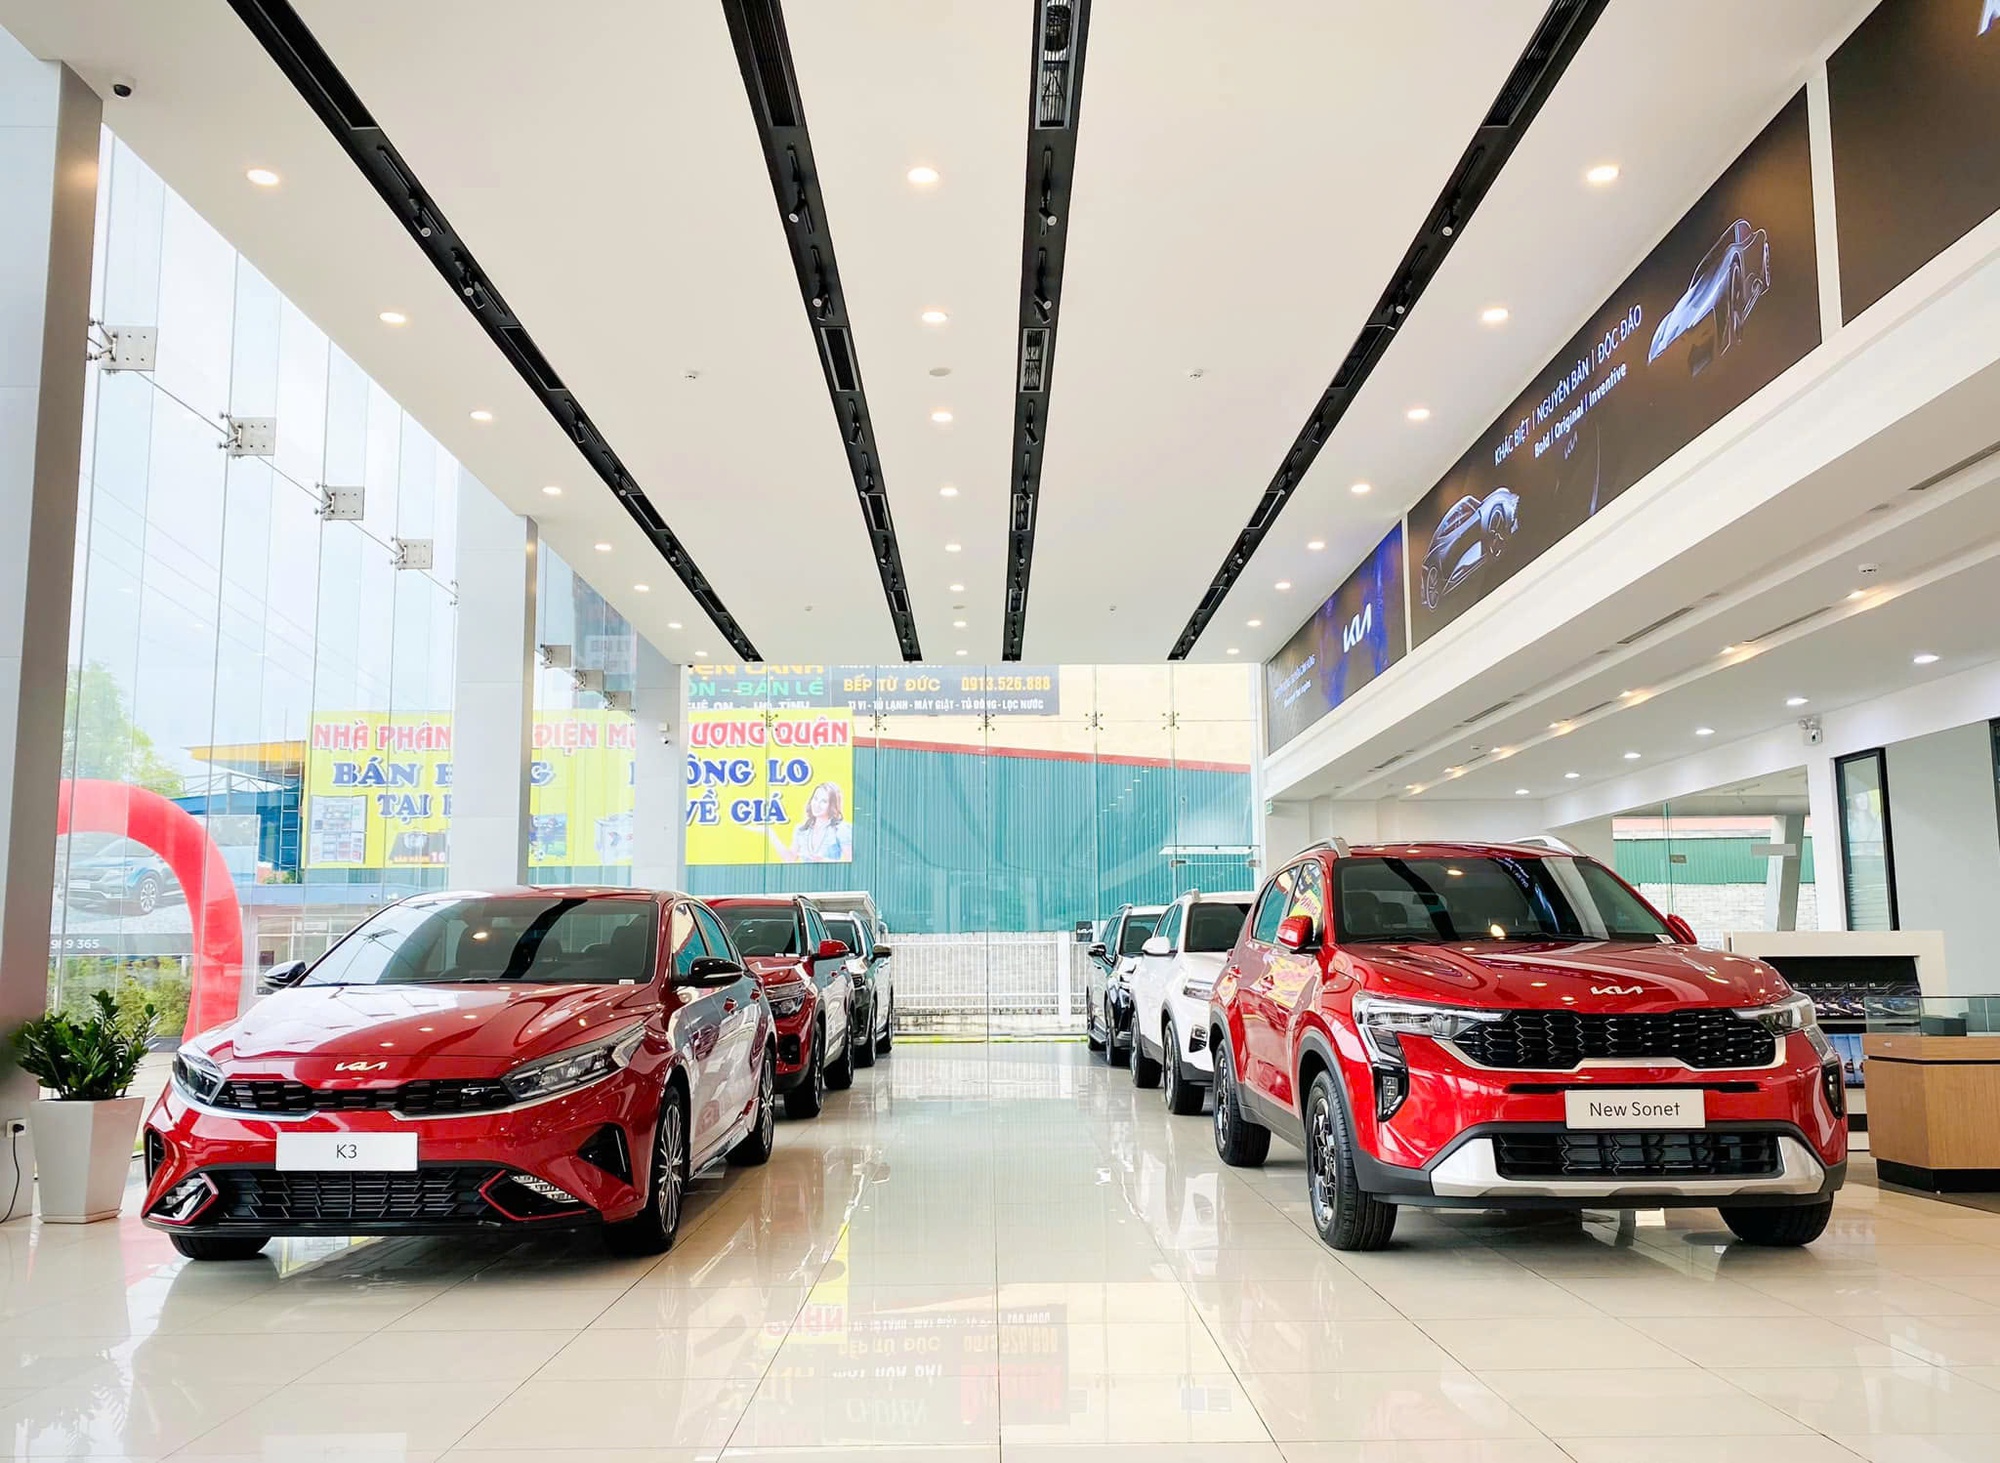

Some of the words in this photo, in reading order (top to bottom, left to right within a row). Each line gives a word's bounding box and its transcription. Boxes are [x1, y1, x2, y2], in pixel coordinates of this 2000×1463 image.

[1494, 435, 1513, 466] KHÁC
[1514, 417, 1530, 443] BIỆT
[1537, 376, 1570, 424] NGUYÊN
[1571, 357, 1590, 391] BẢN
[1597, 328, 1618, 364] ĐỘC
[1620, 304, 1642, 341] ĐÁO
[1534, 432, 1550, 458] Bold
[1554, 400, 1584, 439] Original
[1589, 362, 1627, 407] Inventive
[1343, 602, 1372, 653] KIA
[737, 677, 790, 697] BÁN
[843, 673, 872, 692] BẾP
[905, 673, 941, 692] ĐỨC
[885, 699, 908, 712] LẠNH
[914, 698, 933, 710] MÁY
[314, 720, 369, 750] NHÀ
[378, 721, 451, 750] PHÂN
[534, 719, 597, 754] ĐIỆN
[775, 716, 848, 747] QUÂN
[332, 757, 418, 785] BÁN
[768, 759, 809, 783] LO
[377, 794, 431, 822] TẠI
[731, 793, 787, 822] GIÁ
[76, 939, 100, 949] 365
[1590, 985, 1644, 995] KIA
[335, 1060, 389, 1071] KIA
[1589, 1102, 1627, 1117] New
[1631, 1101, 1681, 1117] Sonet
[336, 1144, 358, 1159] K3
